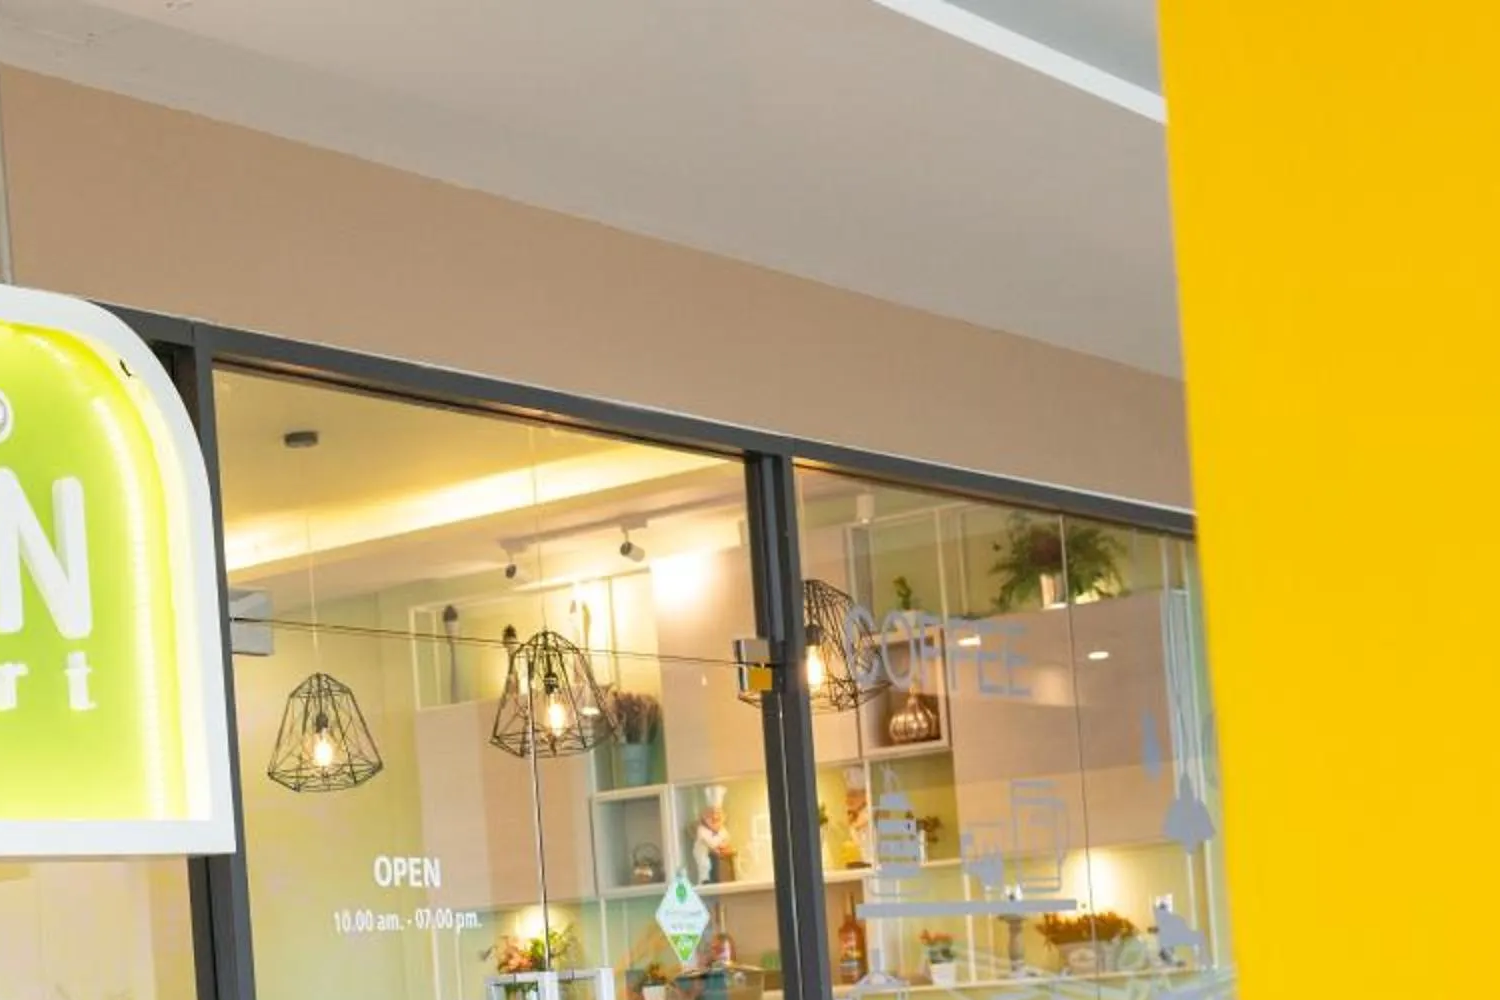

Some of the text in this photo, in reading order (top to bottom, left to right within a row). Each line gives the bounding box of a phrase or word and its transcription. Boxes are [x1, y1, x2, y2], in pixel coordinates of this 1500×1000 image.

[845, 606, 1031, 694] COFFEE
[373, 853, 442, 888] OPEN
[333, 908, 373, 936] 10.00
[415, 906, 454, 931] 07.00
